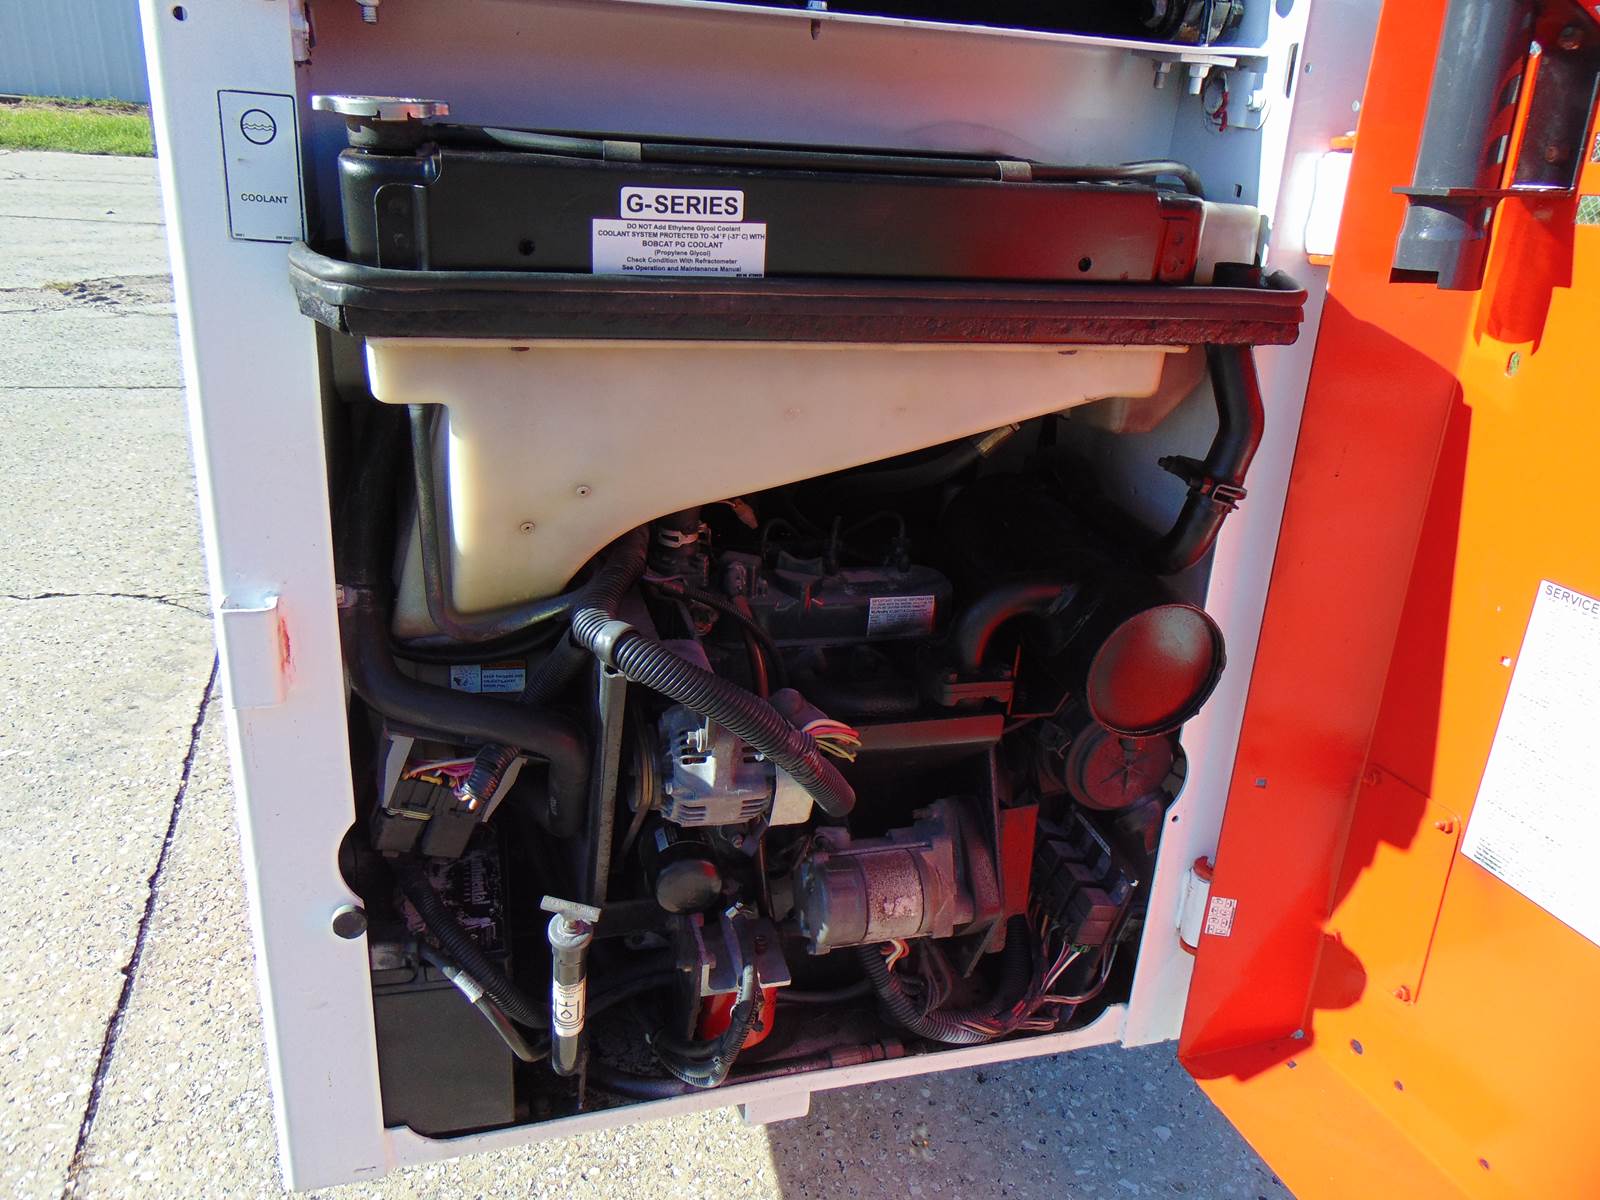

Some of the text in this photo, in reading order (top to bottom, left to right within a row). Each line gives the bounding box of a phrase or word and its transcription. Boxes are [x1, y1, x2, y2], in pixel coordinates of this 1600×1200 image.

[241, 193, 288, 204] COOLANT
[626, 193, 738, 216] G-SERIES
[668, 224, 695, 232] Ethylene
[697, 225, 716, 233] Glycol
[642, 240, 673, 248] BOBCAT
[1544, 584, 1600, 615] SERVICE
